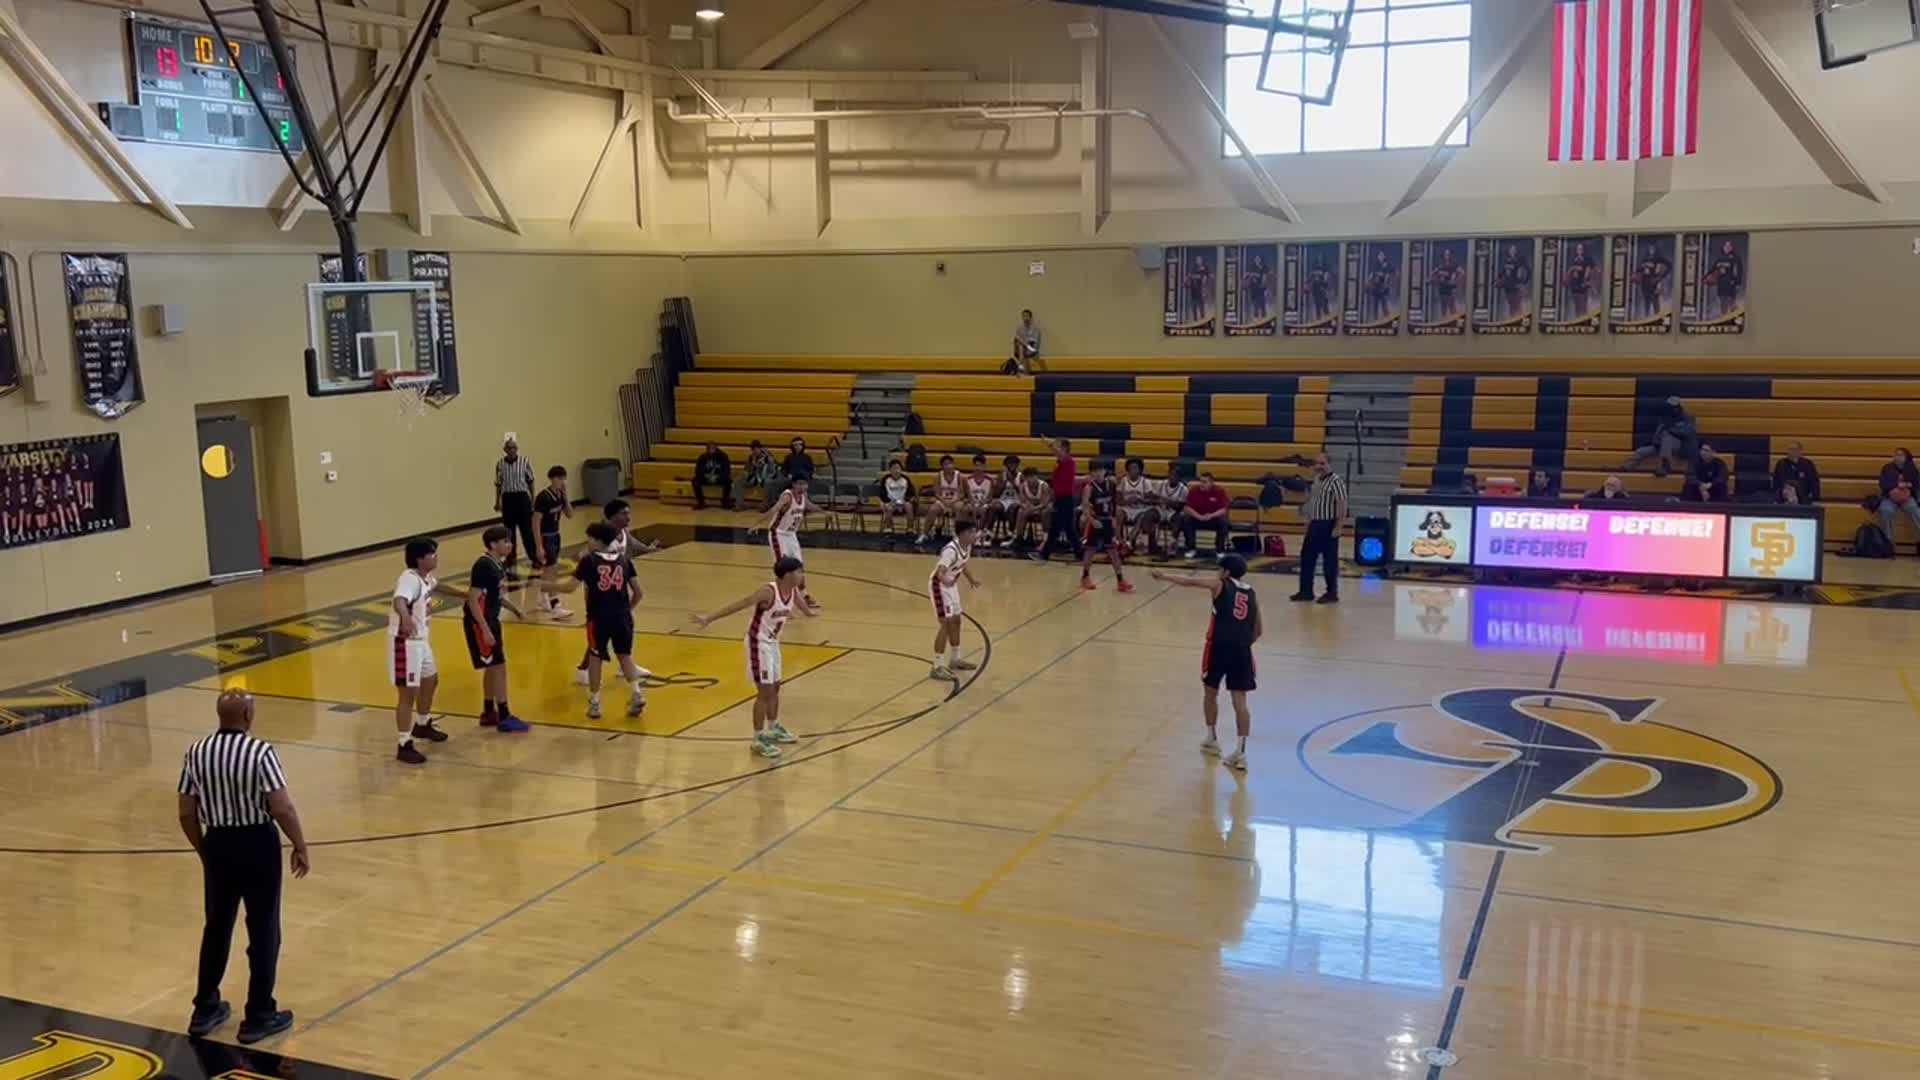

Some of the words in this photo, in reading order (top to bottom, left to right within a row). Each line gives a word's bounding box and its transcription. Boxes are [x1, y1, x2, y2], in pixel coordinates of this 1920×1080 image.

[141, 26, 173, 42] HOME
[413, 267, 449, 277] PIRATES
[87, 517, 115, 530] 2024
[1489, 510, 1589, 532] DEFENSE!
[1608, 513, 1714, 538] DEFENSE!
[1488, 537, 1588, 559] DEFENSE!
[597, 564, 624, 591] 34
[1232, 591, 1249, 620] 5
